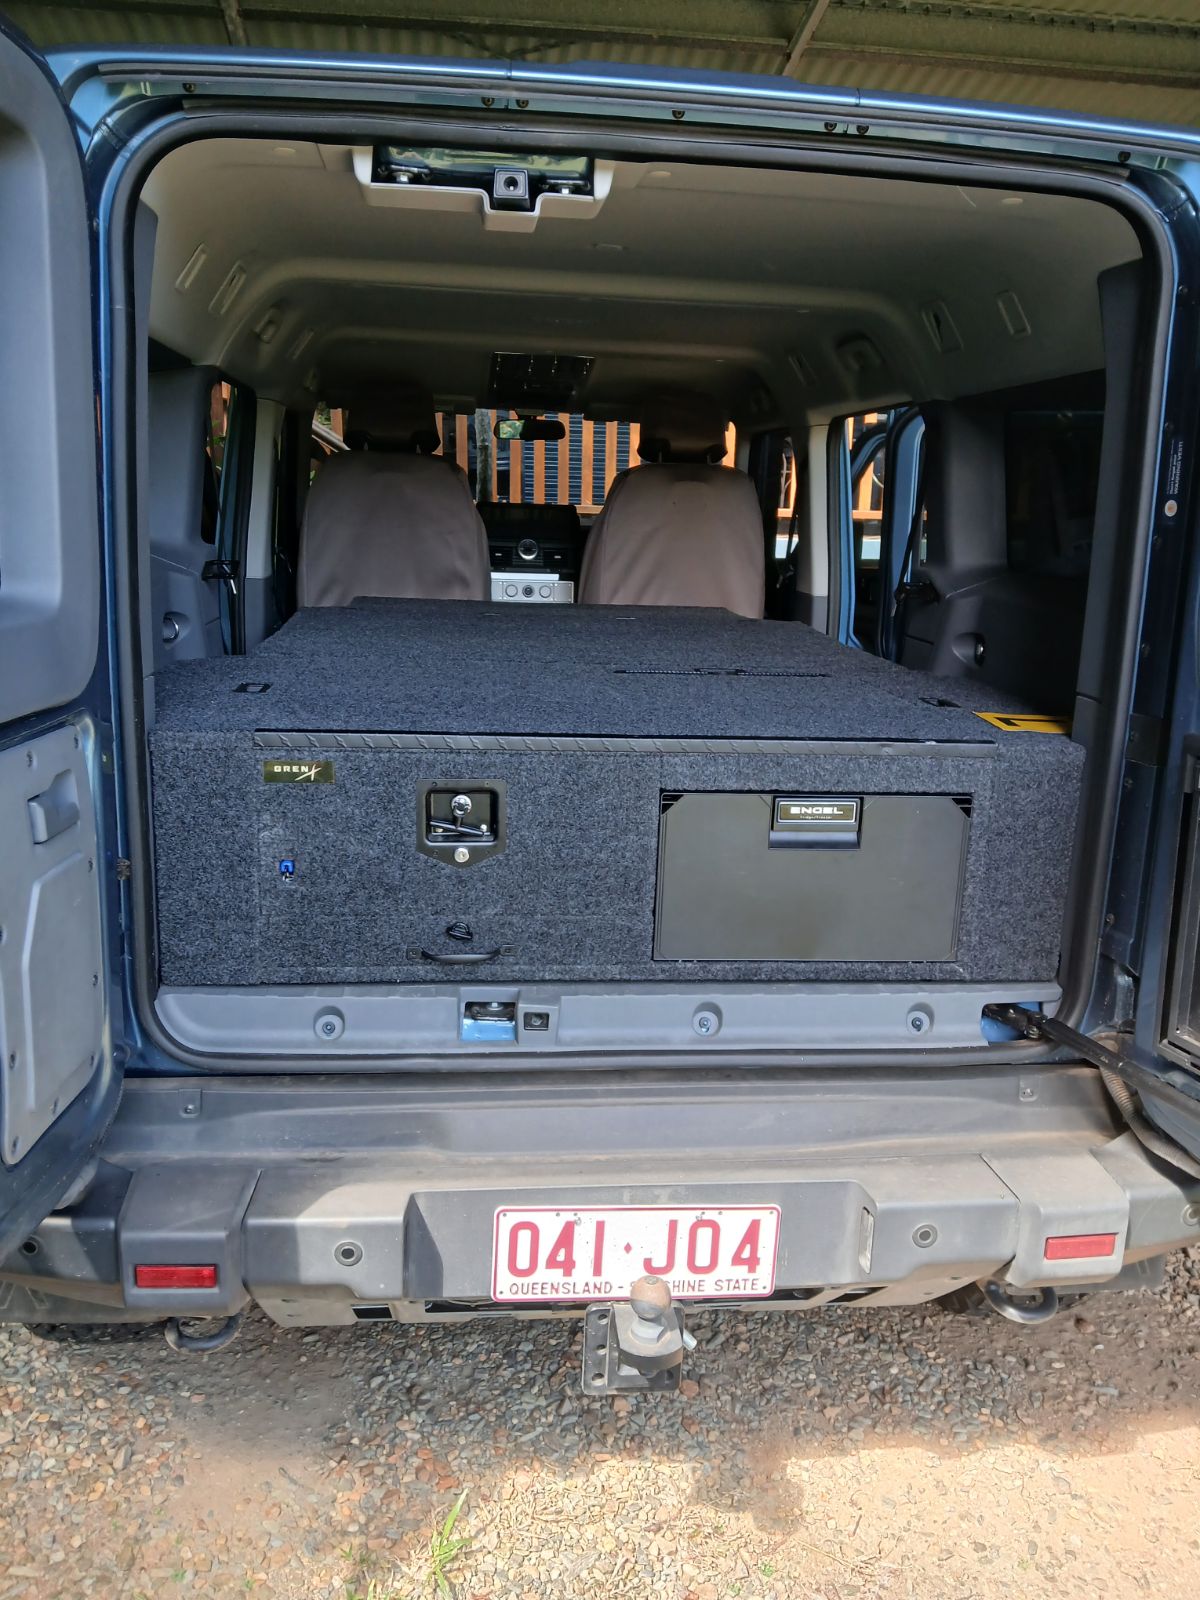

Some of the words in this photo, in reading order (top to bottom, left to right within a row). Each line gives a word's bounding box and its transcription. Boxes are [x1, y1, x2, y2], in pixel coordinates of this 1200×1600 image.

[790, 806, 844, 814] ENGEL
[507, 1220, 605, 1277] 041
[509, 1281, 612, 1295] QUEENSLAND
[714, 1278, 760, 1291] STATE
